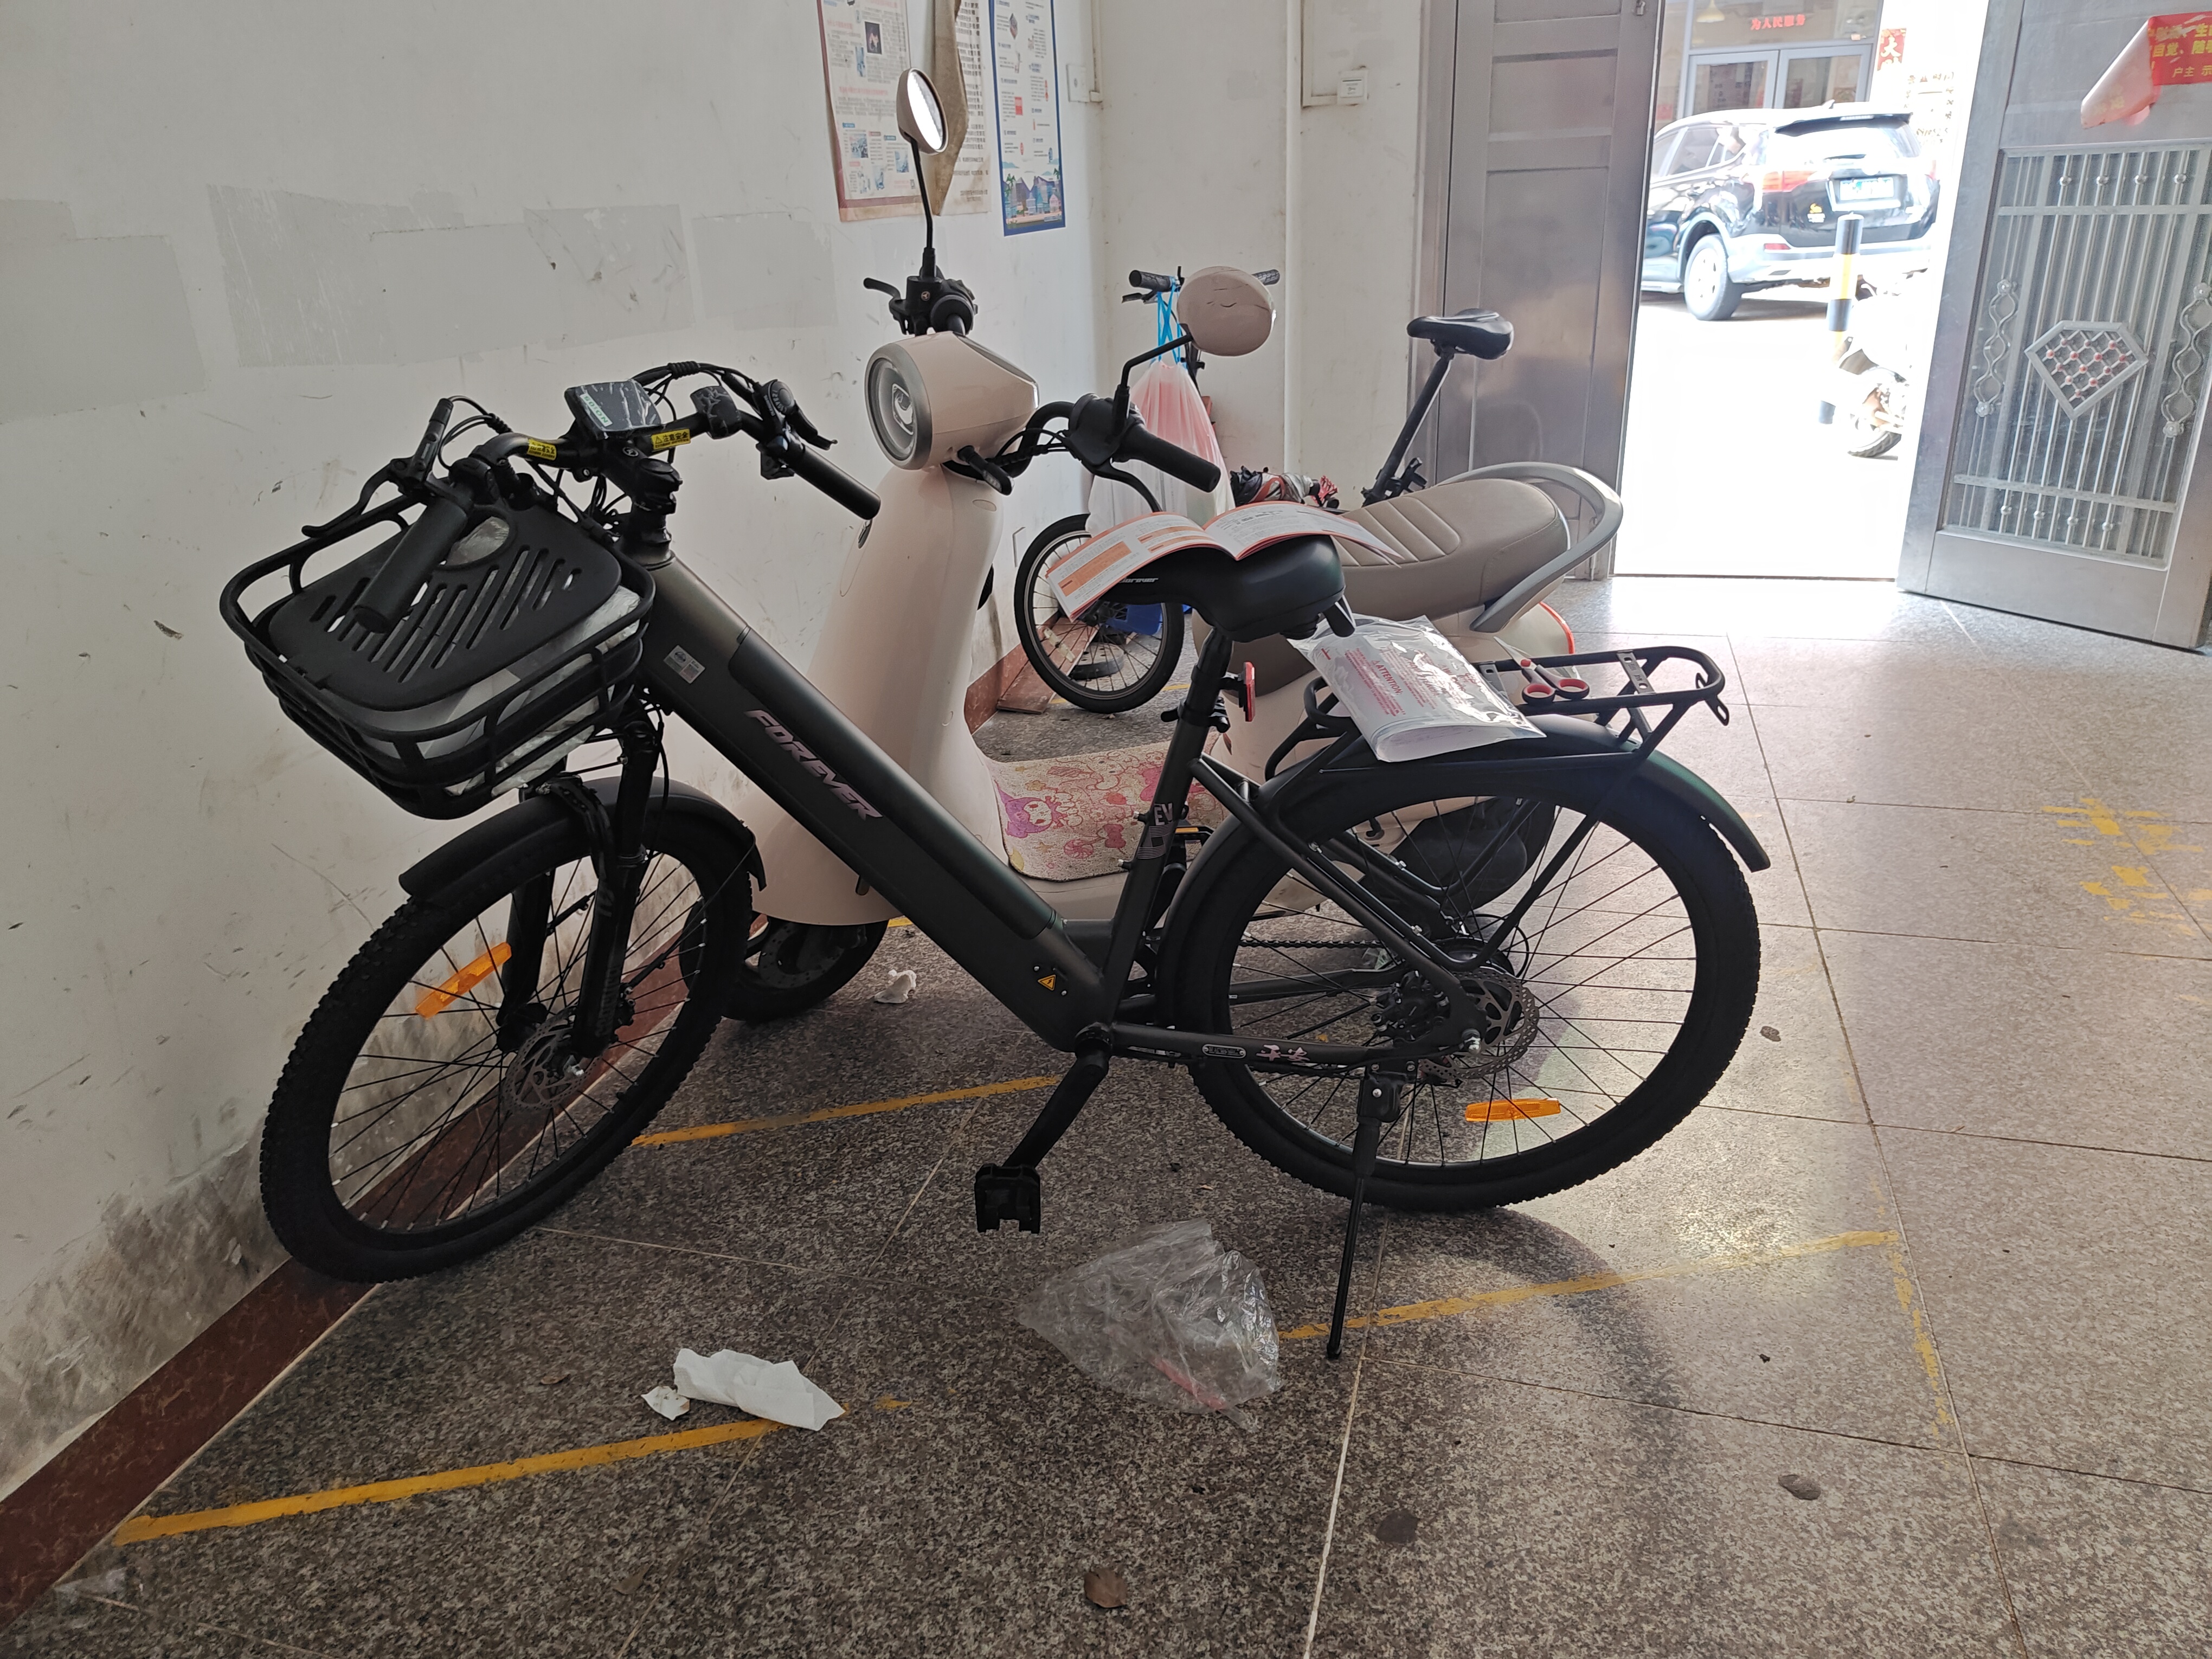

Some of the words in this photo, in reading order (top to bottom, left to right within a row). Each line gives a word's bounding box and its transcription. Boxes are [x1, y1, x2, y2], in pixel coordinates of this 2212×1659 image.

[1750, 14, 1806, 30] 为人民服务
[2172, 66, 2195, 78] 户主
[663, 432, 688, 442] 注意安全
[1376, 664, 1403, 695] ATTENTION:
[744, 710, 883, 821] FOREVER
